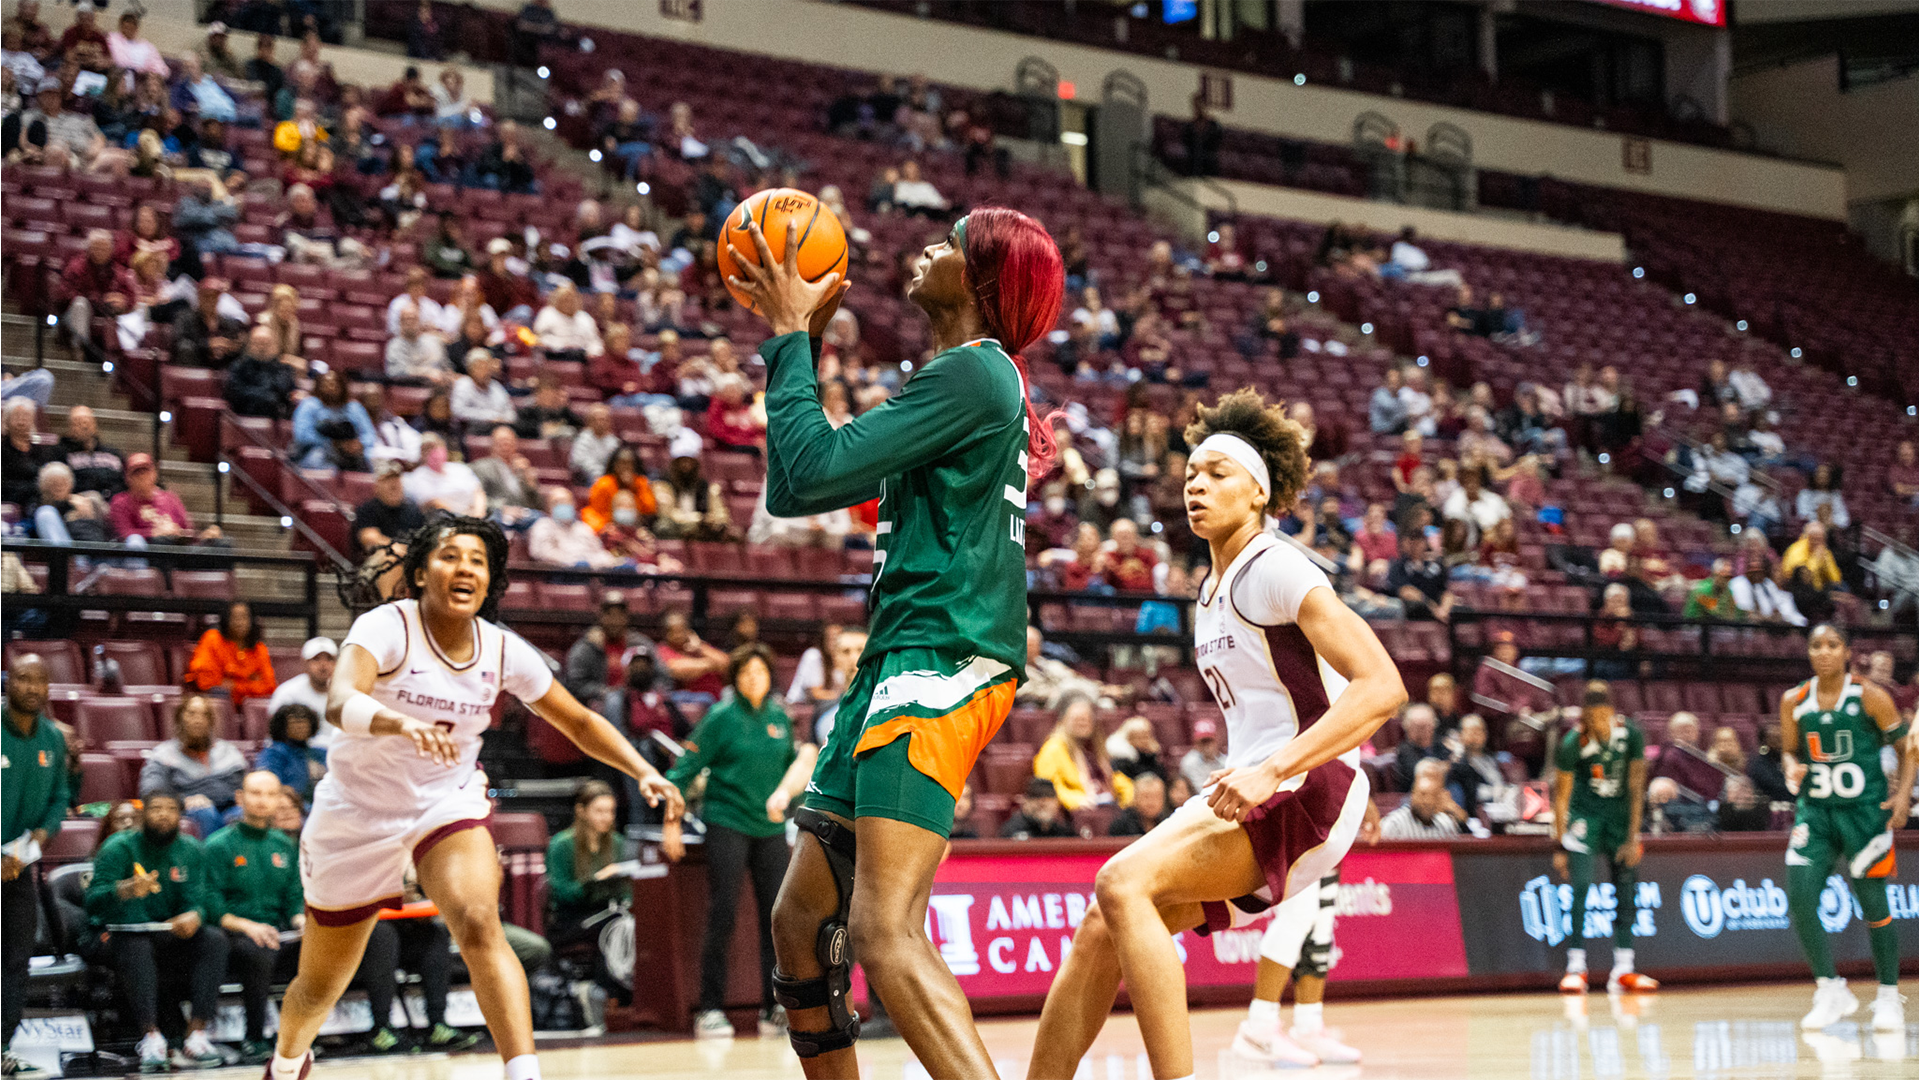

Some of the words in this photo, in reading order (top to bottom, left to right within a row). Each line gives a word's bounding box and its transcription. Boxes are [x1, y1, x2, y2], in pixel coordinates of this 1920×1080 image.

[1209, 635, 1236, 654] STATE
[397, 689, 456, 714] FLORIDA
[1204, 664, 1236, 710] 21
[1806, 729, 1853, 763] U
[1808, 762, 1866, 798] 30
[986, 893, 1098, 930] AMER
